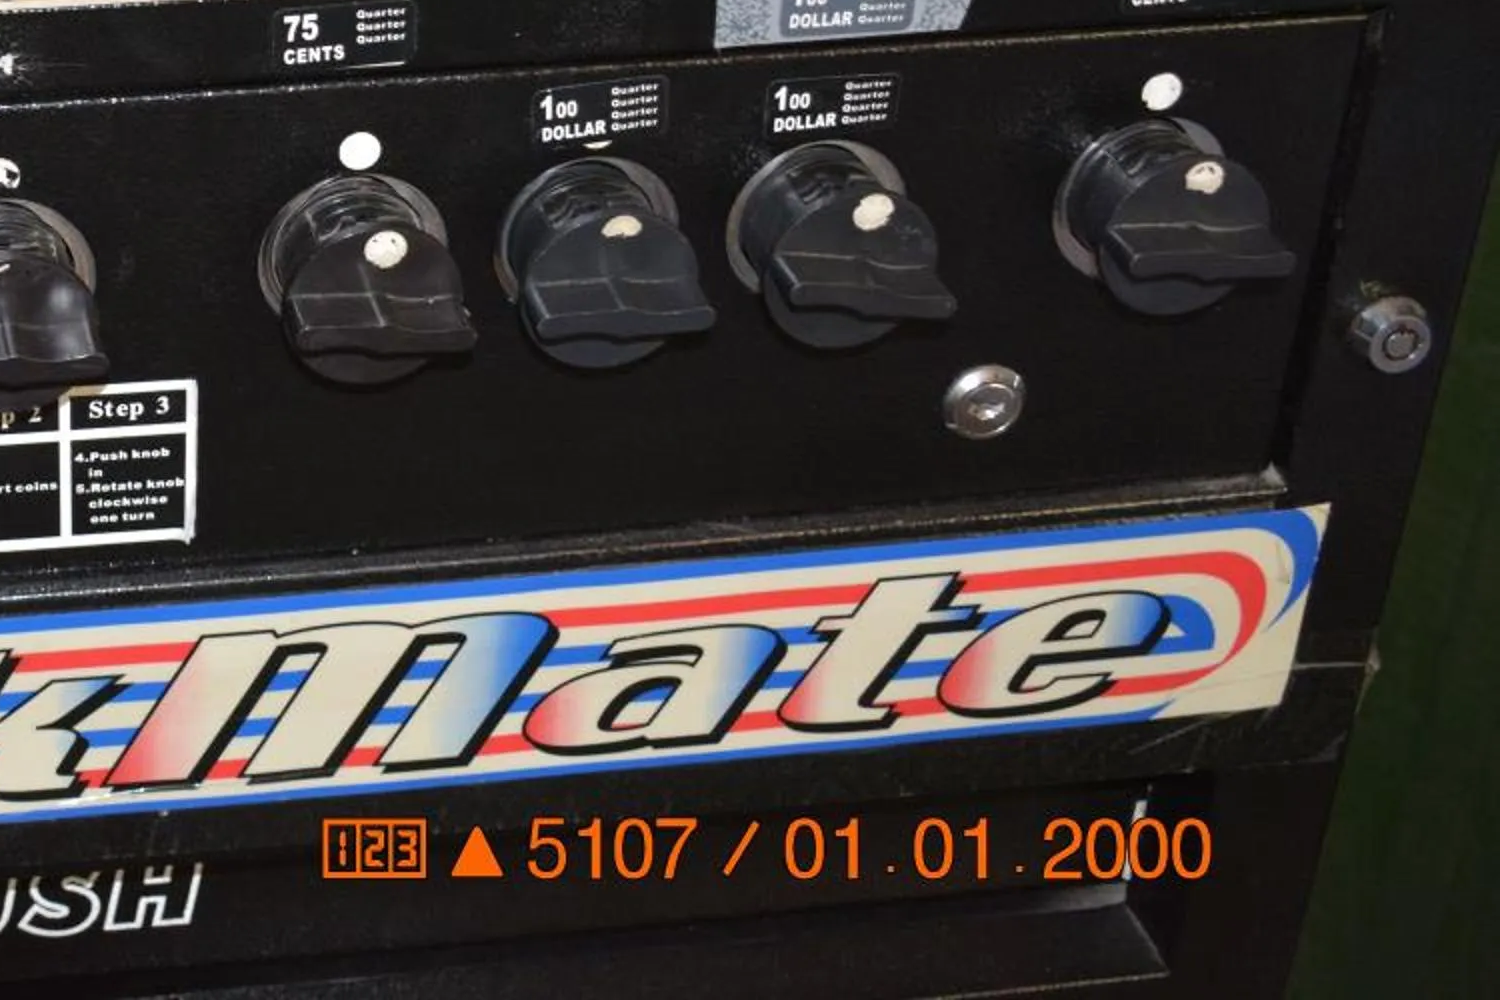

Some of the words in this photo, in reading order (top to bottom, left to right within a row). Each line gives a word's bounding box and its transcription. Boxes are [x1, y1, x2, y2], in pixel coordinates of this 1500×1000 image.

[859, 1, 906, 11] Quarter
[356, 8, 407, 19] Quarter
[857, 13, 904, 24] Quarter
[356, 20, 407, 32] Quarter
[788, 11, 853, 29] DOLLAR
[283, 13, 319, 43] 75
[356, 33, 406, 44] Quarter
[283, 44, 345, 65] CENTS
[611, 83, 659, 95] Quarter
[845, 80, 892, 90] Quarter
[611, 95, 658, 108] Quarter
[843, 91, 891, 101] Quarter
[611, 107, 658, 119] Quarter
[842, 102, 889, 113] Quarter
[773, 112, 837, 133] DOLLAR
[841, 113, 887, 124] Quarter
[541, 119, 607, 143] DOLLAR
[611, 119, 658, 131] Quarter
[28, 405, 43, 424] 2
[88, 400, 145, 421] Step
[156, 396, 171, 415] 3
[74, 449, 128, 464] 4.Push
[131, 447, 171, 460] knob
[88, 466, 103, 478] in
[14, 480, 58, 493] coins
[75, 480, 143, 495] 5.Rotate
[146, 477, 185, 489] knob
[88, 495, 168, 509] clockwise
[90, 513, 119, 525] one
[121, 510, 155, 523] turn
